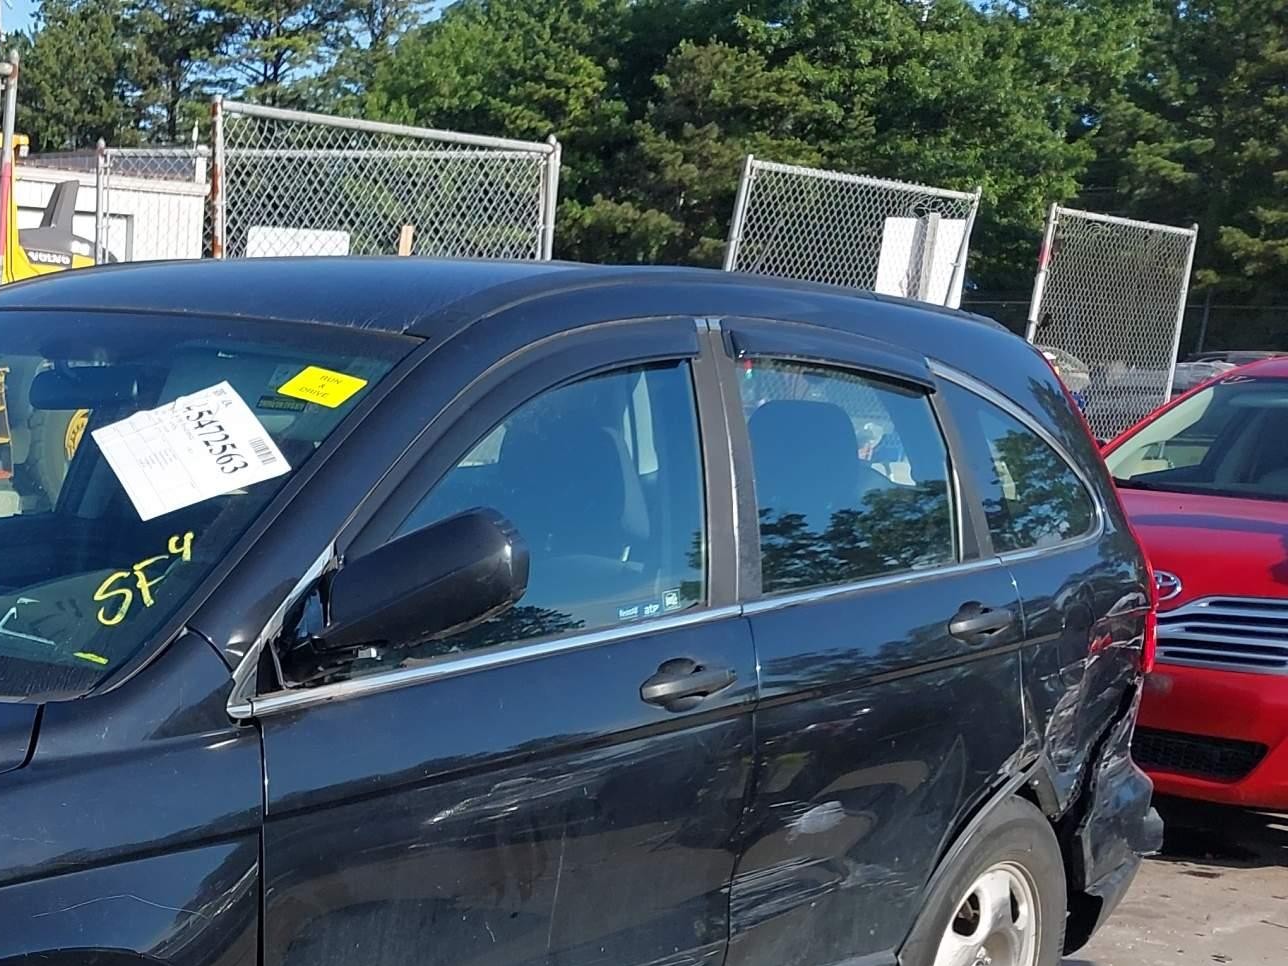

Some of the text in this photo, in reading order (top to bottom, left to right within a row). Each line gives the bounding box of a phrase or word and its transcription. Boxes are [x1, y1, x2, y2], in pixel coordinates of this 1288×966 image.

[27, 251, 71, 265] VOLVO
[319, 375, 343, 385] RUN
[298, 386, 330, 399] DRIVE
